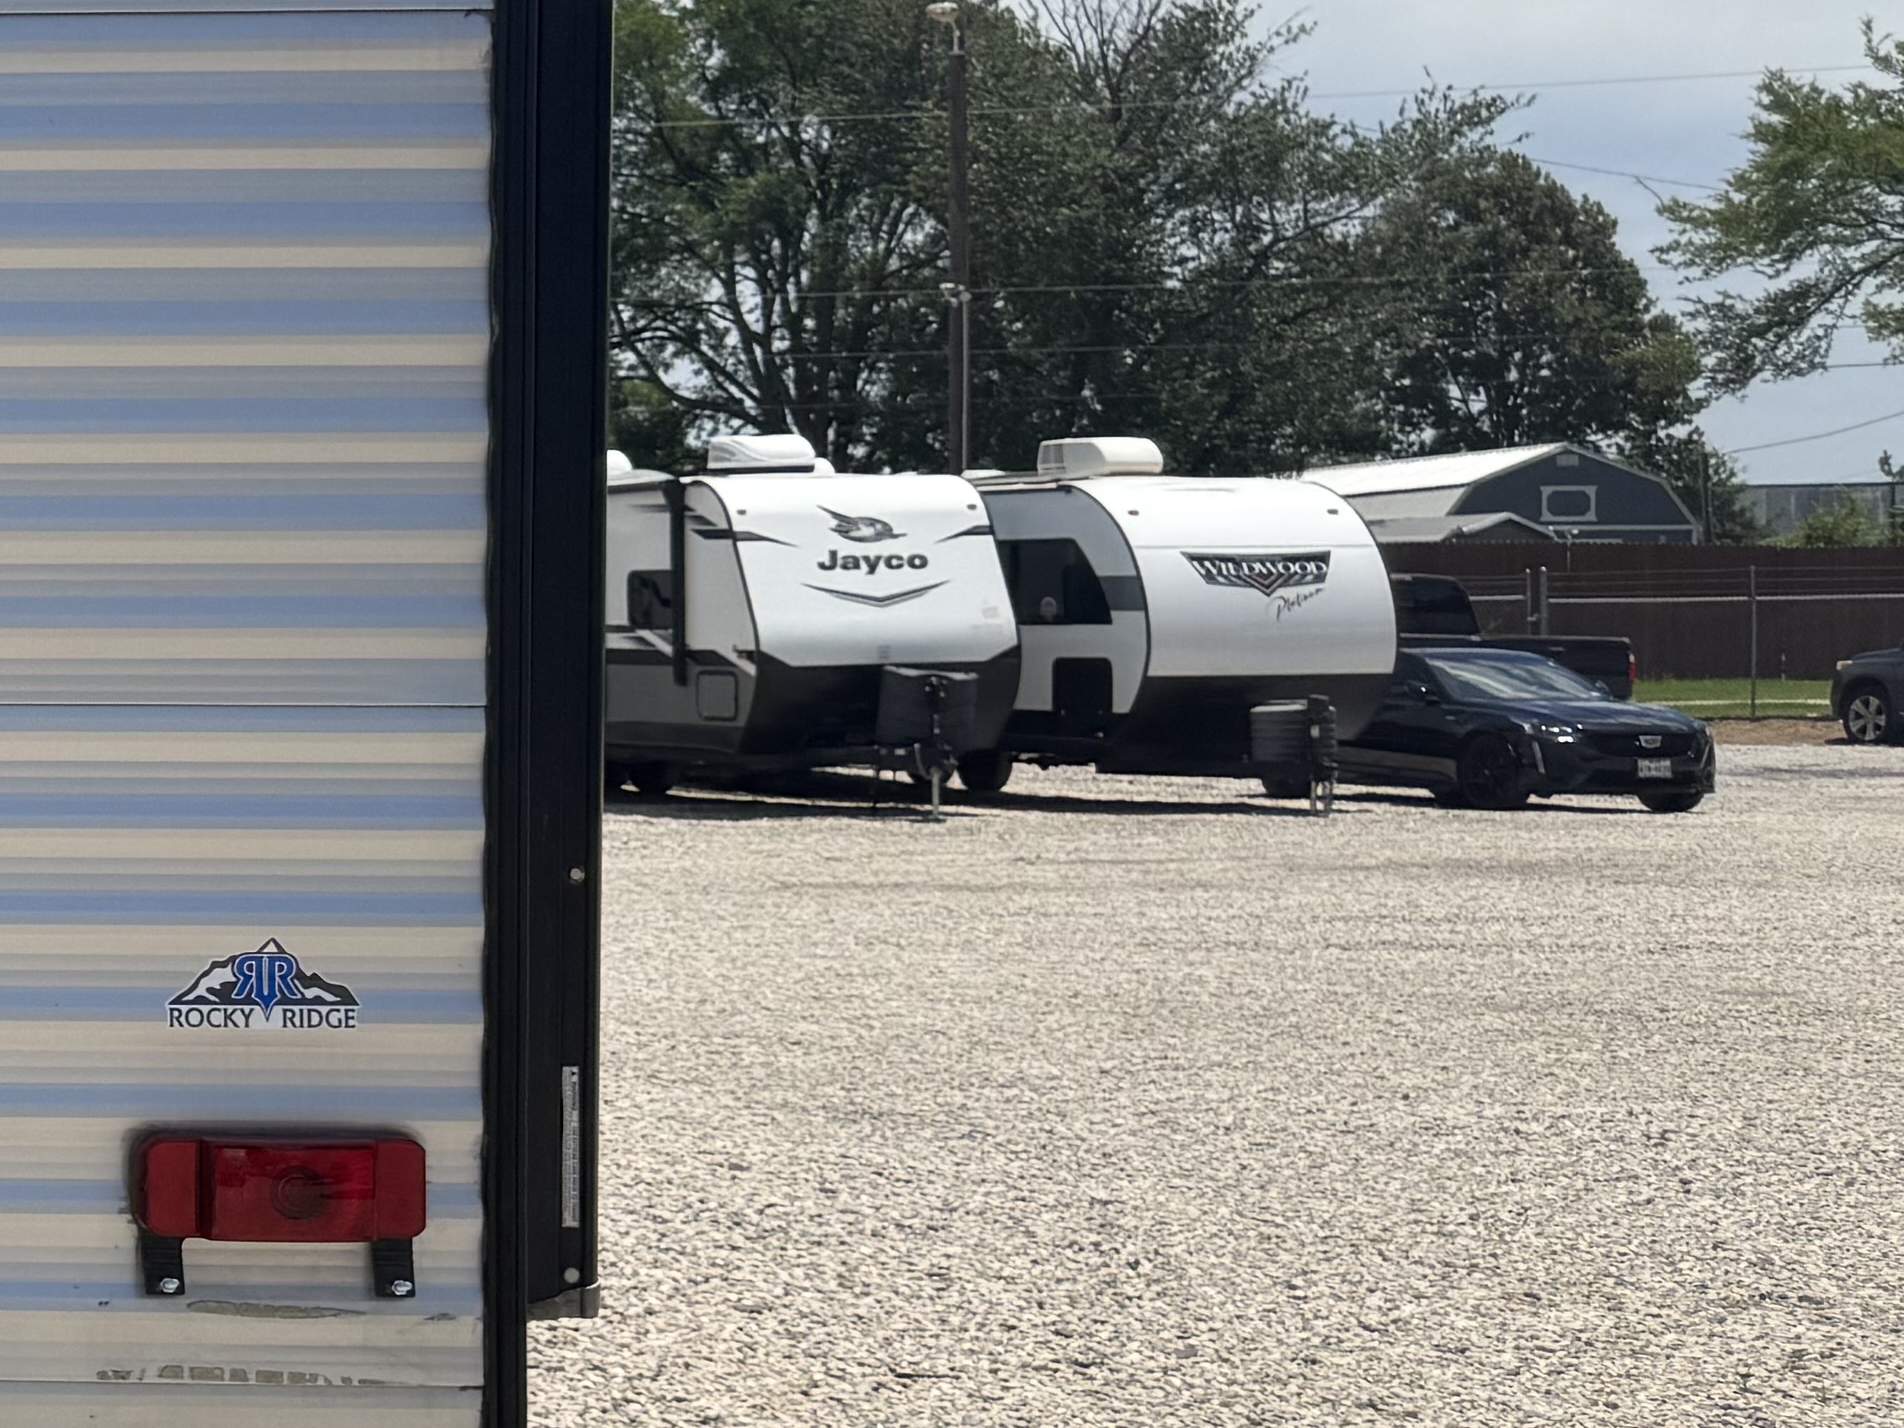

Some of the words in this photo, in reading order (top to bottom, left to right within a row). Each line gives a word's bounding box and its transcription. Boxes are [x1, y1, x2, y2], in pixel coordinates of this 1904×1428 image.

[816, 549, 929, 575] Jayco
[1192, 559, 1328, 576] WILDWOOD
[169, 1007, 255, 1028] ROCKY
[282, 1008, 357, 1029] RIDGE
